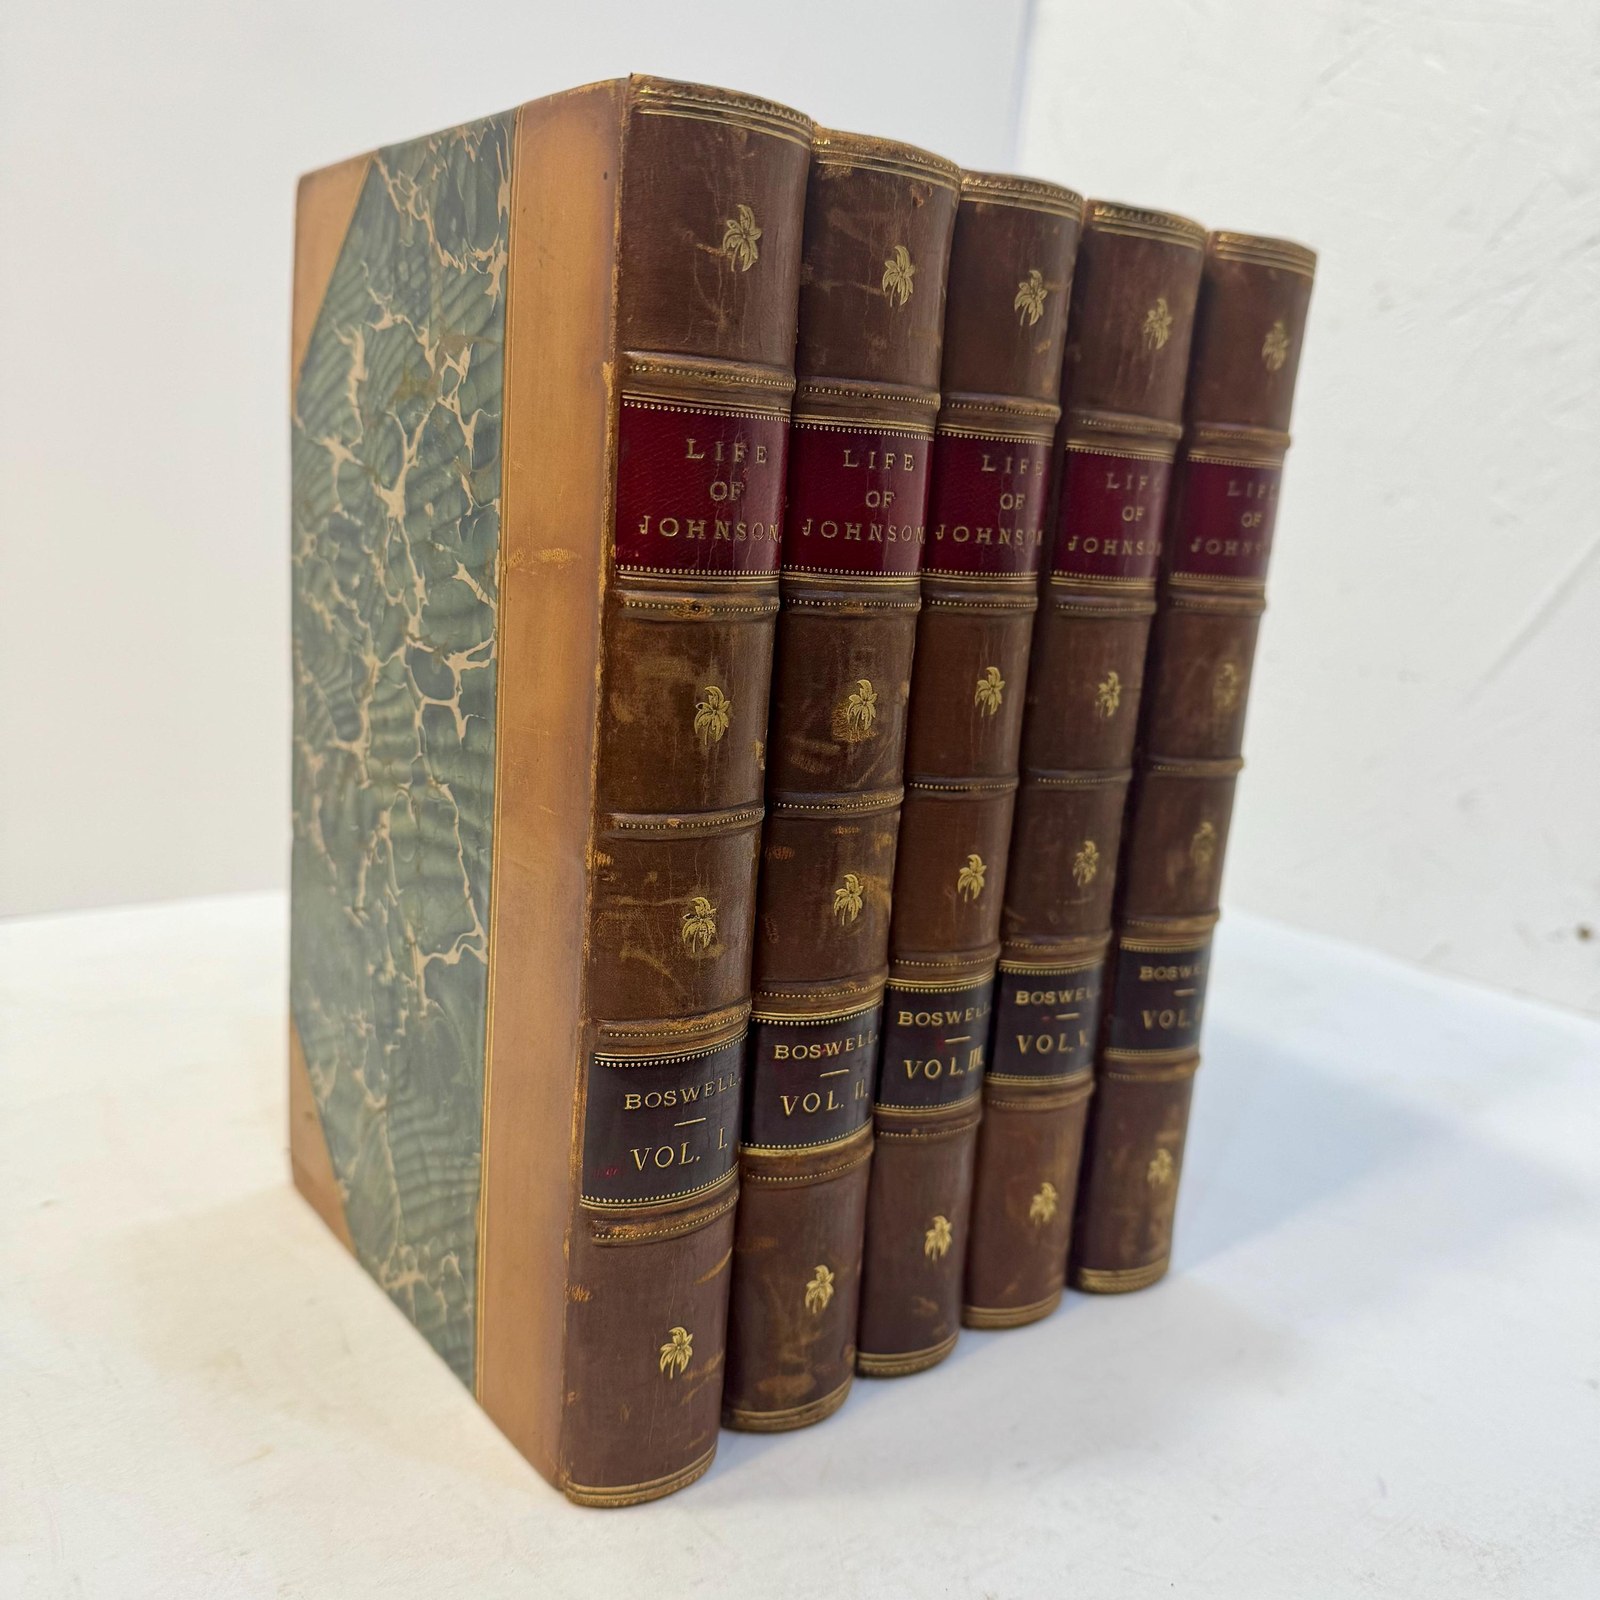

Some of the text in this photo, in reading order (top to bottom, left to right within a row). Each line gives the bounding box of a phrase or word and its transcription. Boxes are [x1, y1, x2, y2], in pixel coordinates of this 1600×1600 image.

[685, 438, 768, 464] LIFE
[842, 449, 914, 471] LIFE
[709, 481, 745, 501] OF
[865, 491, 897, 508] OF
[1000, 493, 1025, 510] OF
[1122, 505, 1145, 521] OF
[1241, 511, 1262, 528] OF
[1016, 1033, 1075, 1056] VOL.
[780, 1079, 869, 1117] VOL. II.
[630, 1126, 728, 1171] VOL. I.
